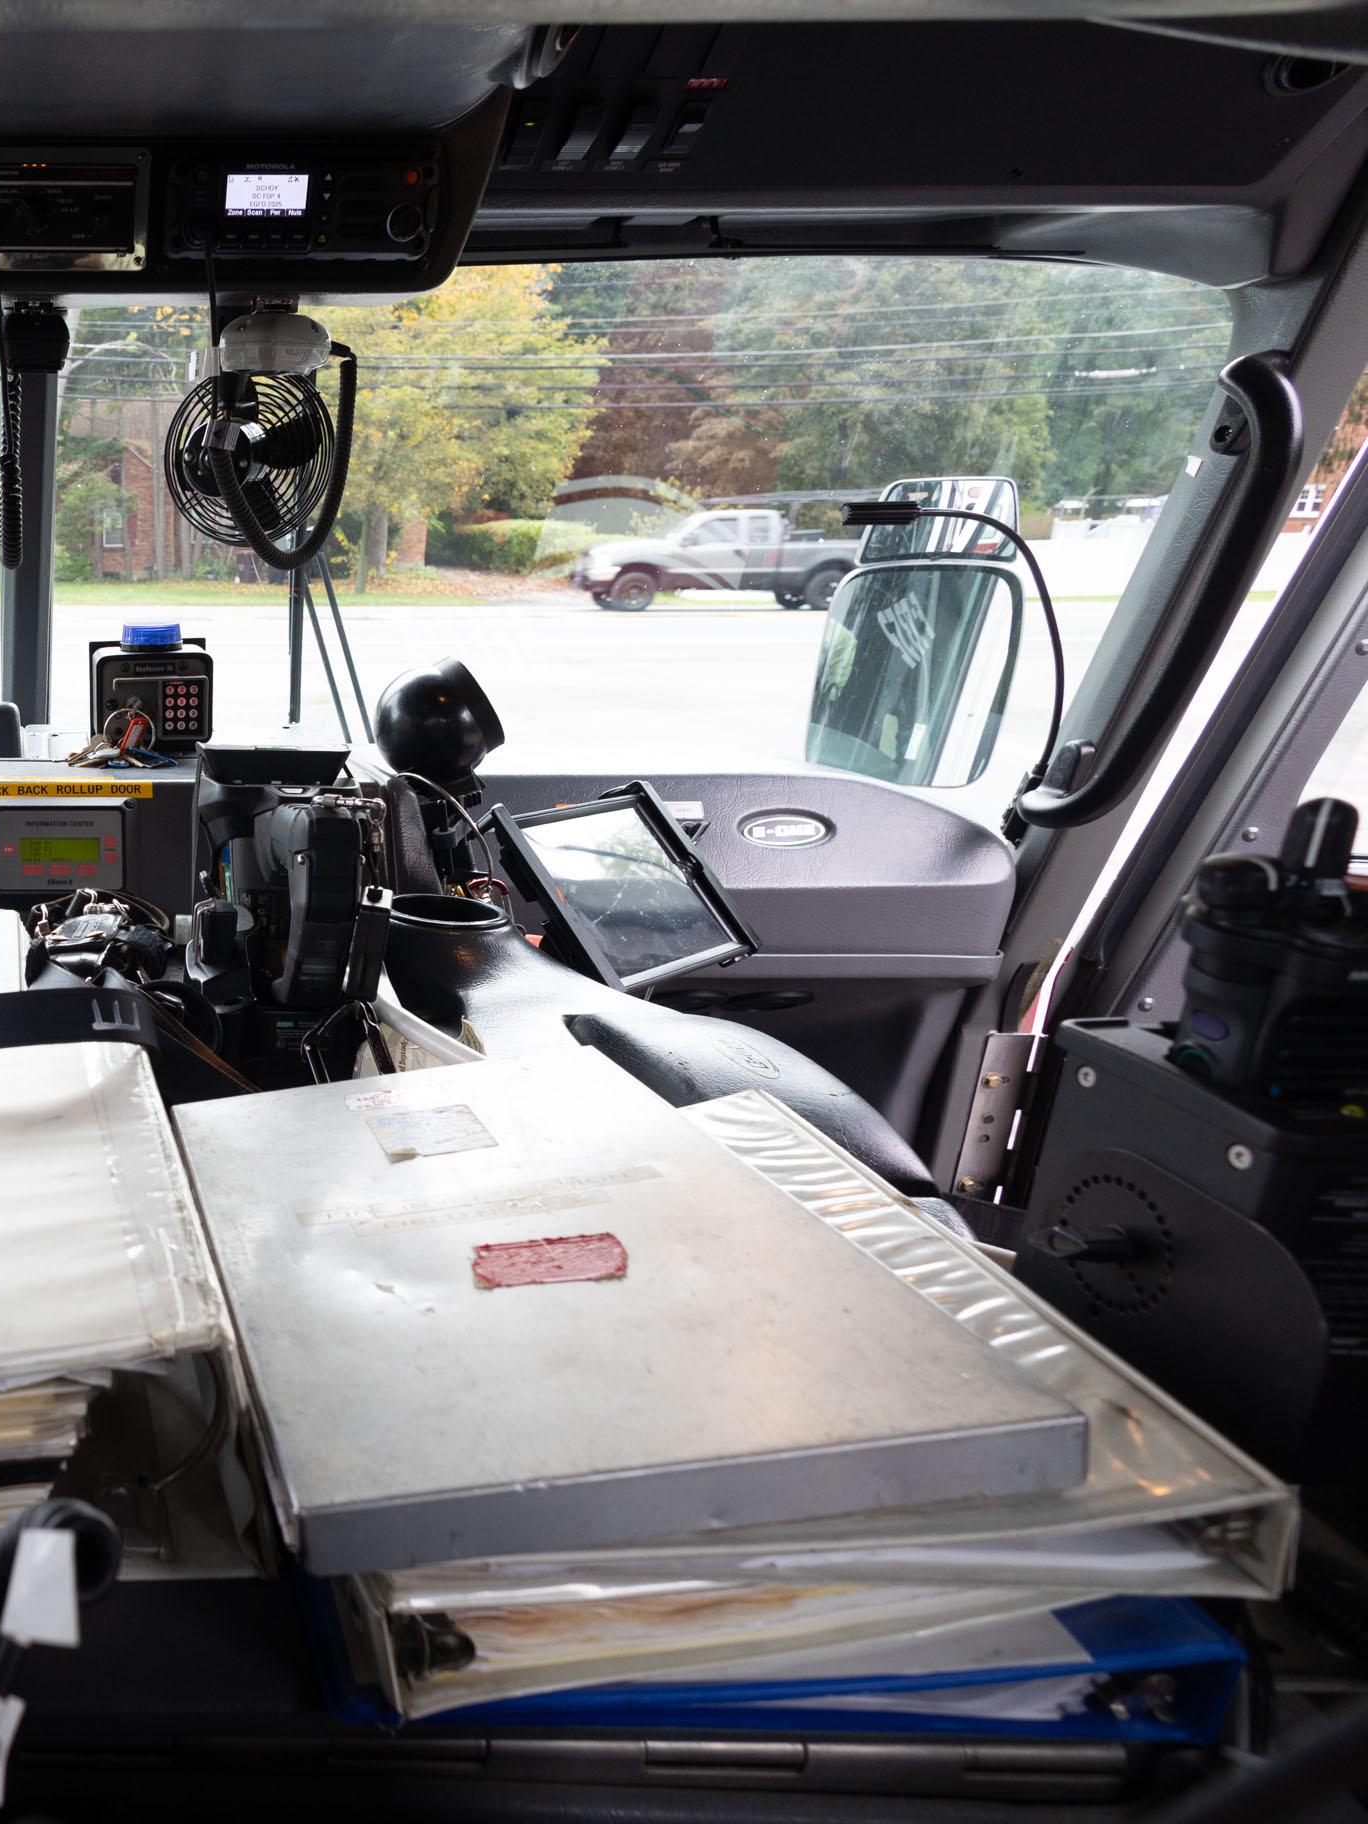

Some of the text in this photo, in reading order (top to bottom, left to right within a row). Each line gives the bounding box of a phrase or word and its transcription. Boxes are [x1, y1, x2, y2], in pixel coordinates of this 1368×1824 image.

[18, 785, 48, 795] BACK
[57, 785, 103, 794] ROLLUP
[111, 784, 141, 794] DOOR
[752, 824, 816, 838] E-ONE
